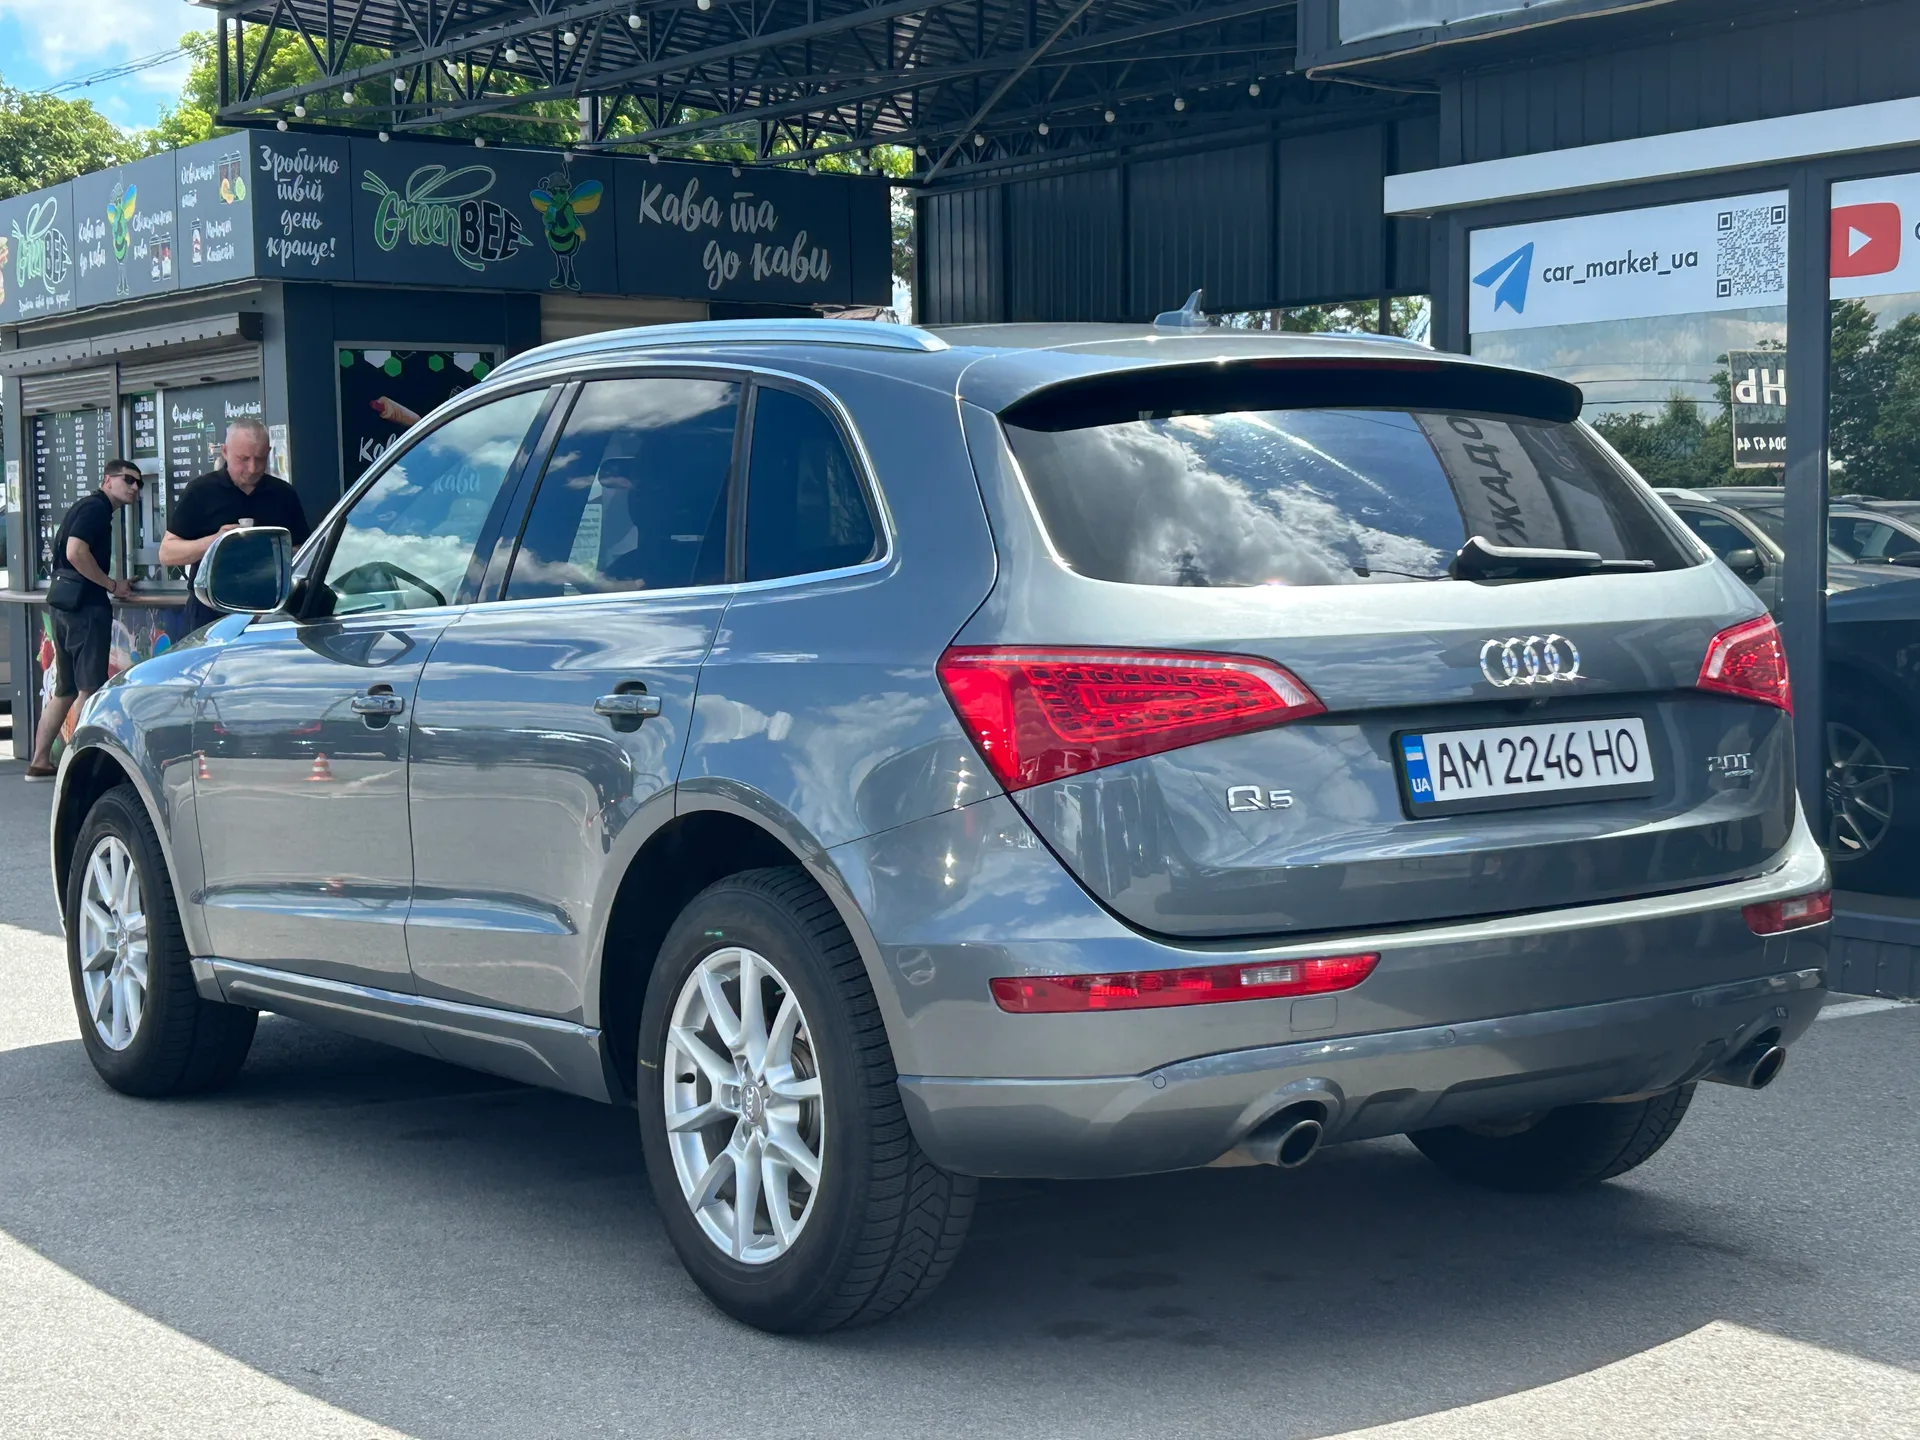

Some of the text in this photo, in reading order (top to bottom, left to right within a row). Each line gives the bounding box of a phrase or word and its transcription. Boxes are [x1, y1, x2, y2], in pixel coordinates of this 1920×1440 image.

[260, 145, 339, 181] Зробимо
[277, 174, 324, 202] твій
[639, 177, 778, 234] Кава та
[281, 209, 322, 236] день
[266, 237, 336, 267] краще!
[703, 230, 831, 290] до кави
[1543, 249, 1698, 284] car_market_ua
[1438, 728, 1638, 791] AM 2246 HO
[1227, 785, 1294, 812] Q5
[1412, 777, 1431, 793] UA
